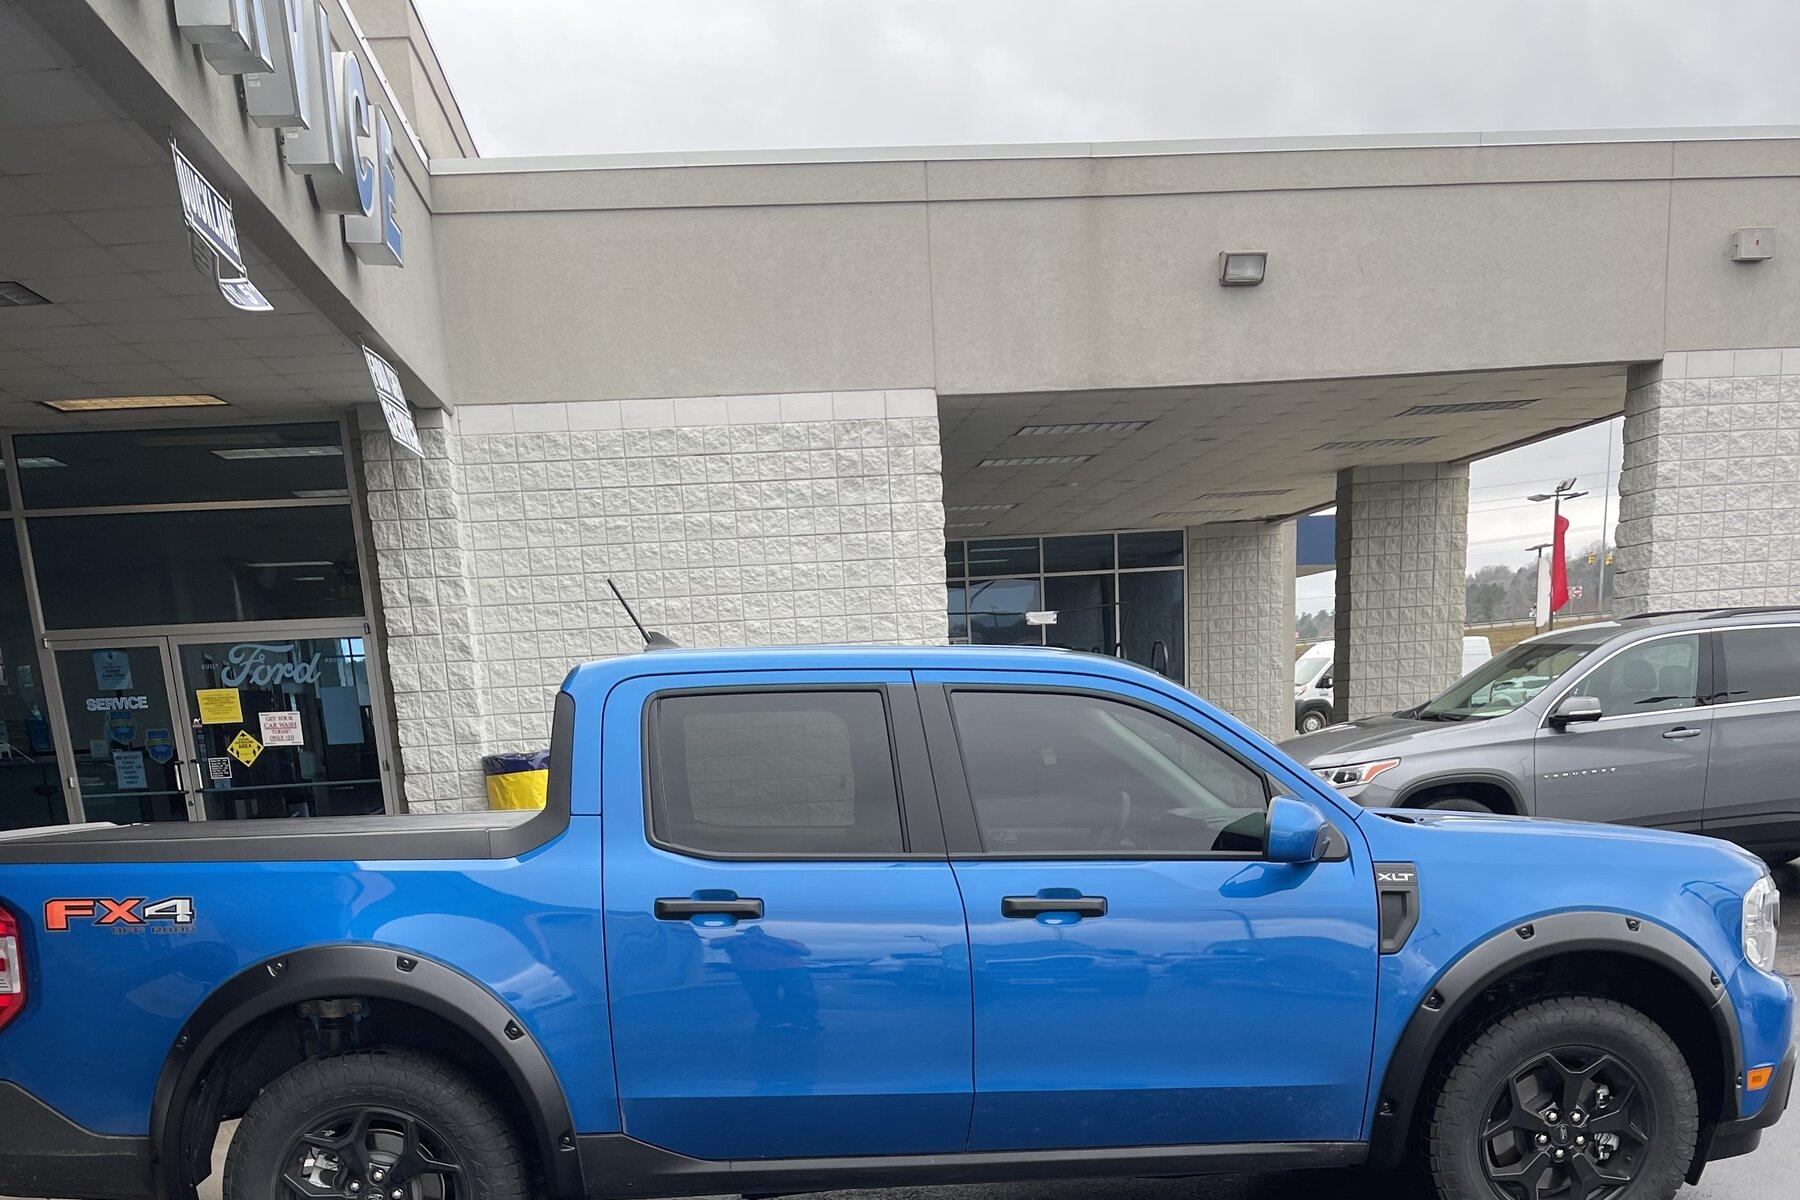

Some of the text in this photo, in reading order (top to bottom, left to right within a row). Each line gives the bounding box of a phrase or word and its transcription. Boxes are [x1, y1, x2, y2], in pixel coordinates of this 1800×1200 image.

[221, 643, 322, 687] Ford
[86, 696, 149, 711] SERVICE
[1377, 872, 1415, 881] XLT
[45, 897, 194, 931] FX4
[112, 926, 195, 934] OFF ROAD
